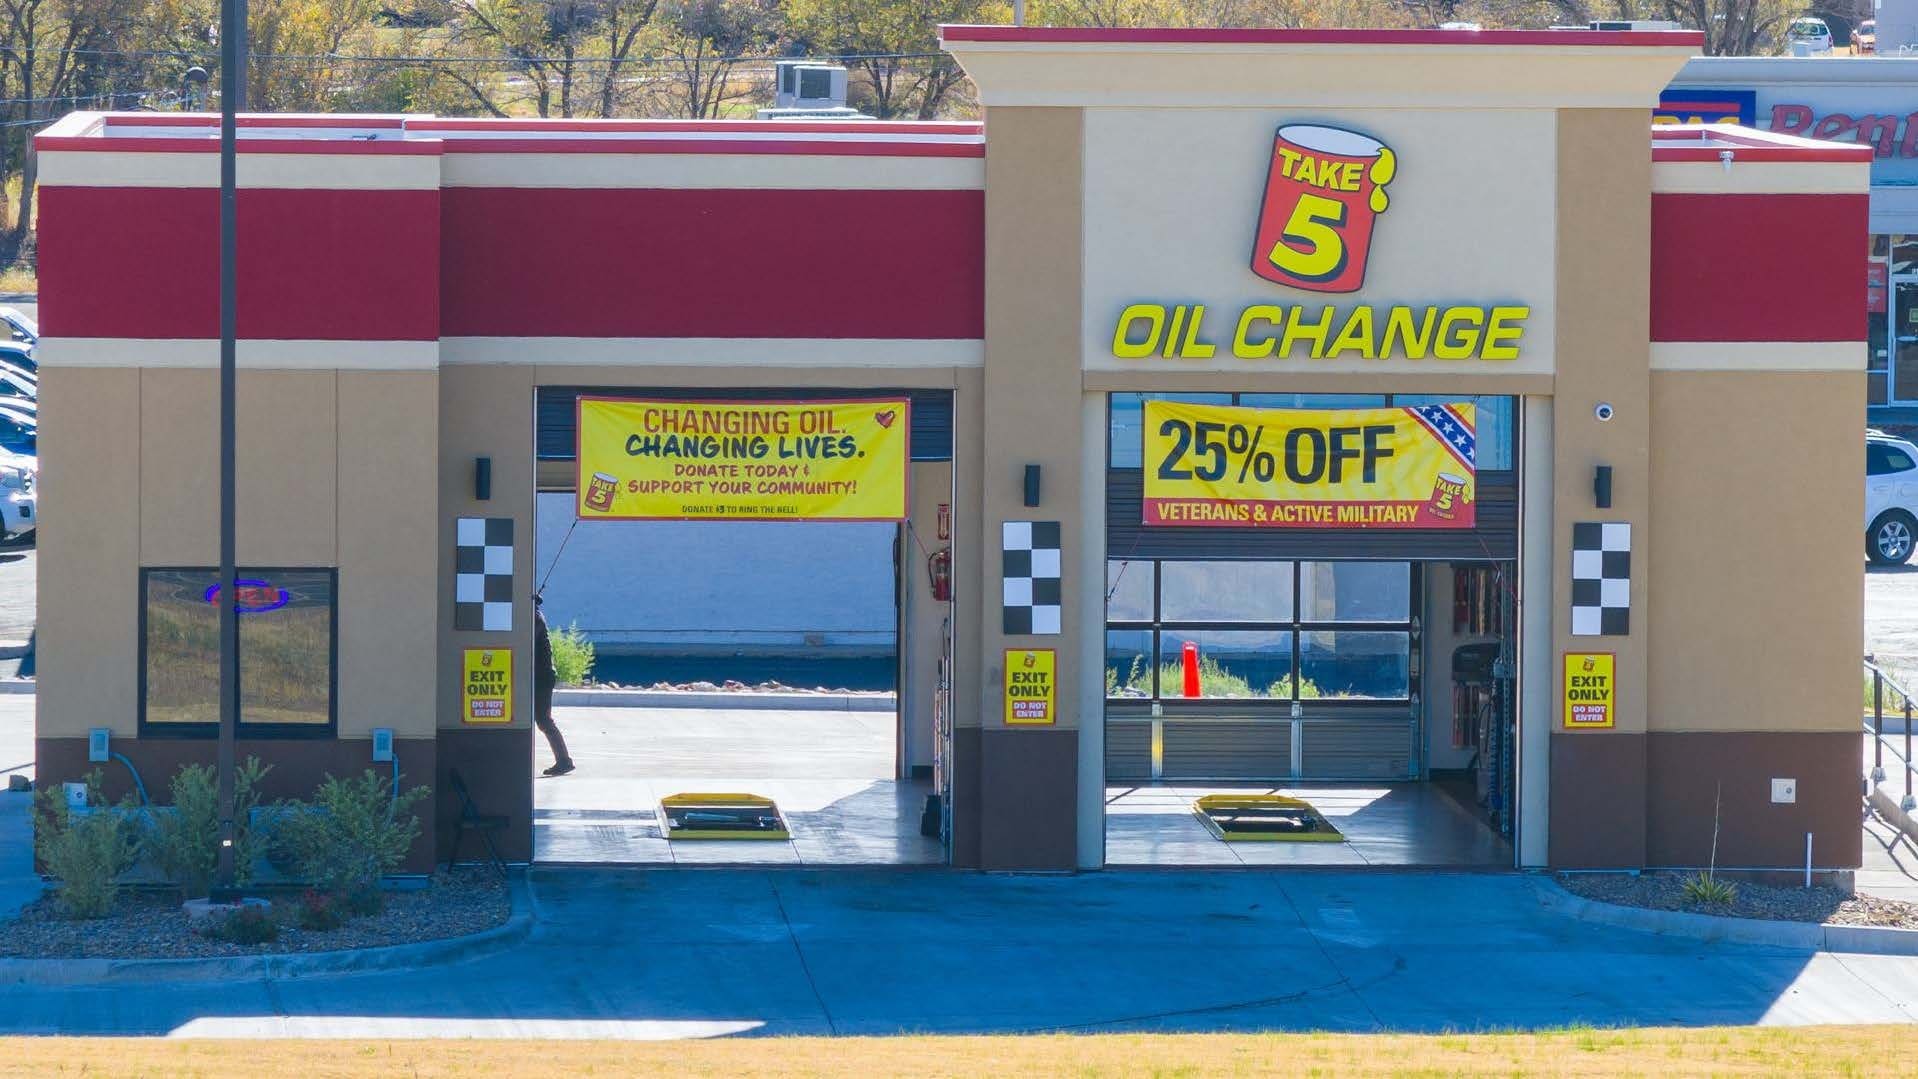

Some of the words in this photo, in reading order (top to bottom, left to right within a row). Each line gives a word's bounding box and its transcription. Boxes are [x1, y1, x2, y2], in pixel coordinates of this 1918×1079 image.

[1278, 147, 1364, 191] TAKE
[1268, 193, 1347, 282] 5
[1112, 304, 1216, 359] OIL
[1232, 304, 1529, 360] CHANGE
[644, 408, 789, 434] CHANGING
[800, 410, 846, 434] OIL.
[625, 434, 770, 459] CHANGING
[779, 435, 865, 459] LIVES.
[1157, 419, 1276, 484] 25%
[1284, 424, 1396, 484] OFF
[675, 463, 739, 477] DONATE
[745, 464, 798, 477] TODAY
[628, 480, 704, 494] SUPPORT
[709, 481, 752, 494] YOUR
[757, 480, 857, 495] COMMUNITY!
[1436, 478, 1461, 496] TAKE
[591, 489, 606, 504] 5
[1436, 493, 1452, 510] 5
[682, 505, 713, 513] DONATE
[727, 505, 737, 514] TO
[739, 505, 758, 514] RING
[760, 505, 775, 514] THE
[1158, 502, 1250, 520] VETERANS
[1253, 504, 1267, 522] &
[1271, 505, 1334, 522] ACTIVE
[1337, 505, 1419, 522] MILITARY
[470, 671, 505, 682] EXIT
[1012, 672, 1048, 683] EXIT
[1571, 676, 1607, 687] EXIT
[467, 684, 508, 696] ONLY
[1009, 685, 1050, 697] ONLY
[1568, 689, 1609, 701] ONLY
[472, 701, 484, 709] DO
[486, 701, 504, 709] NOT
[1573, 705, 1586, 713] DO
[1588, 705, 1606, 713] NOT
